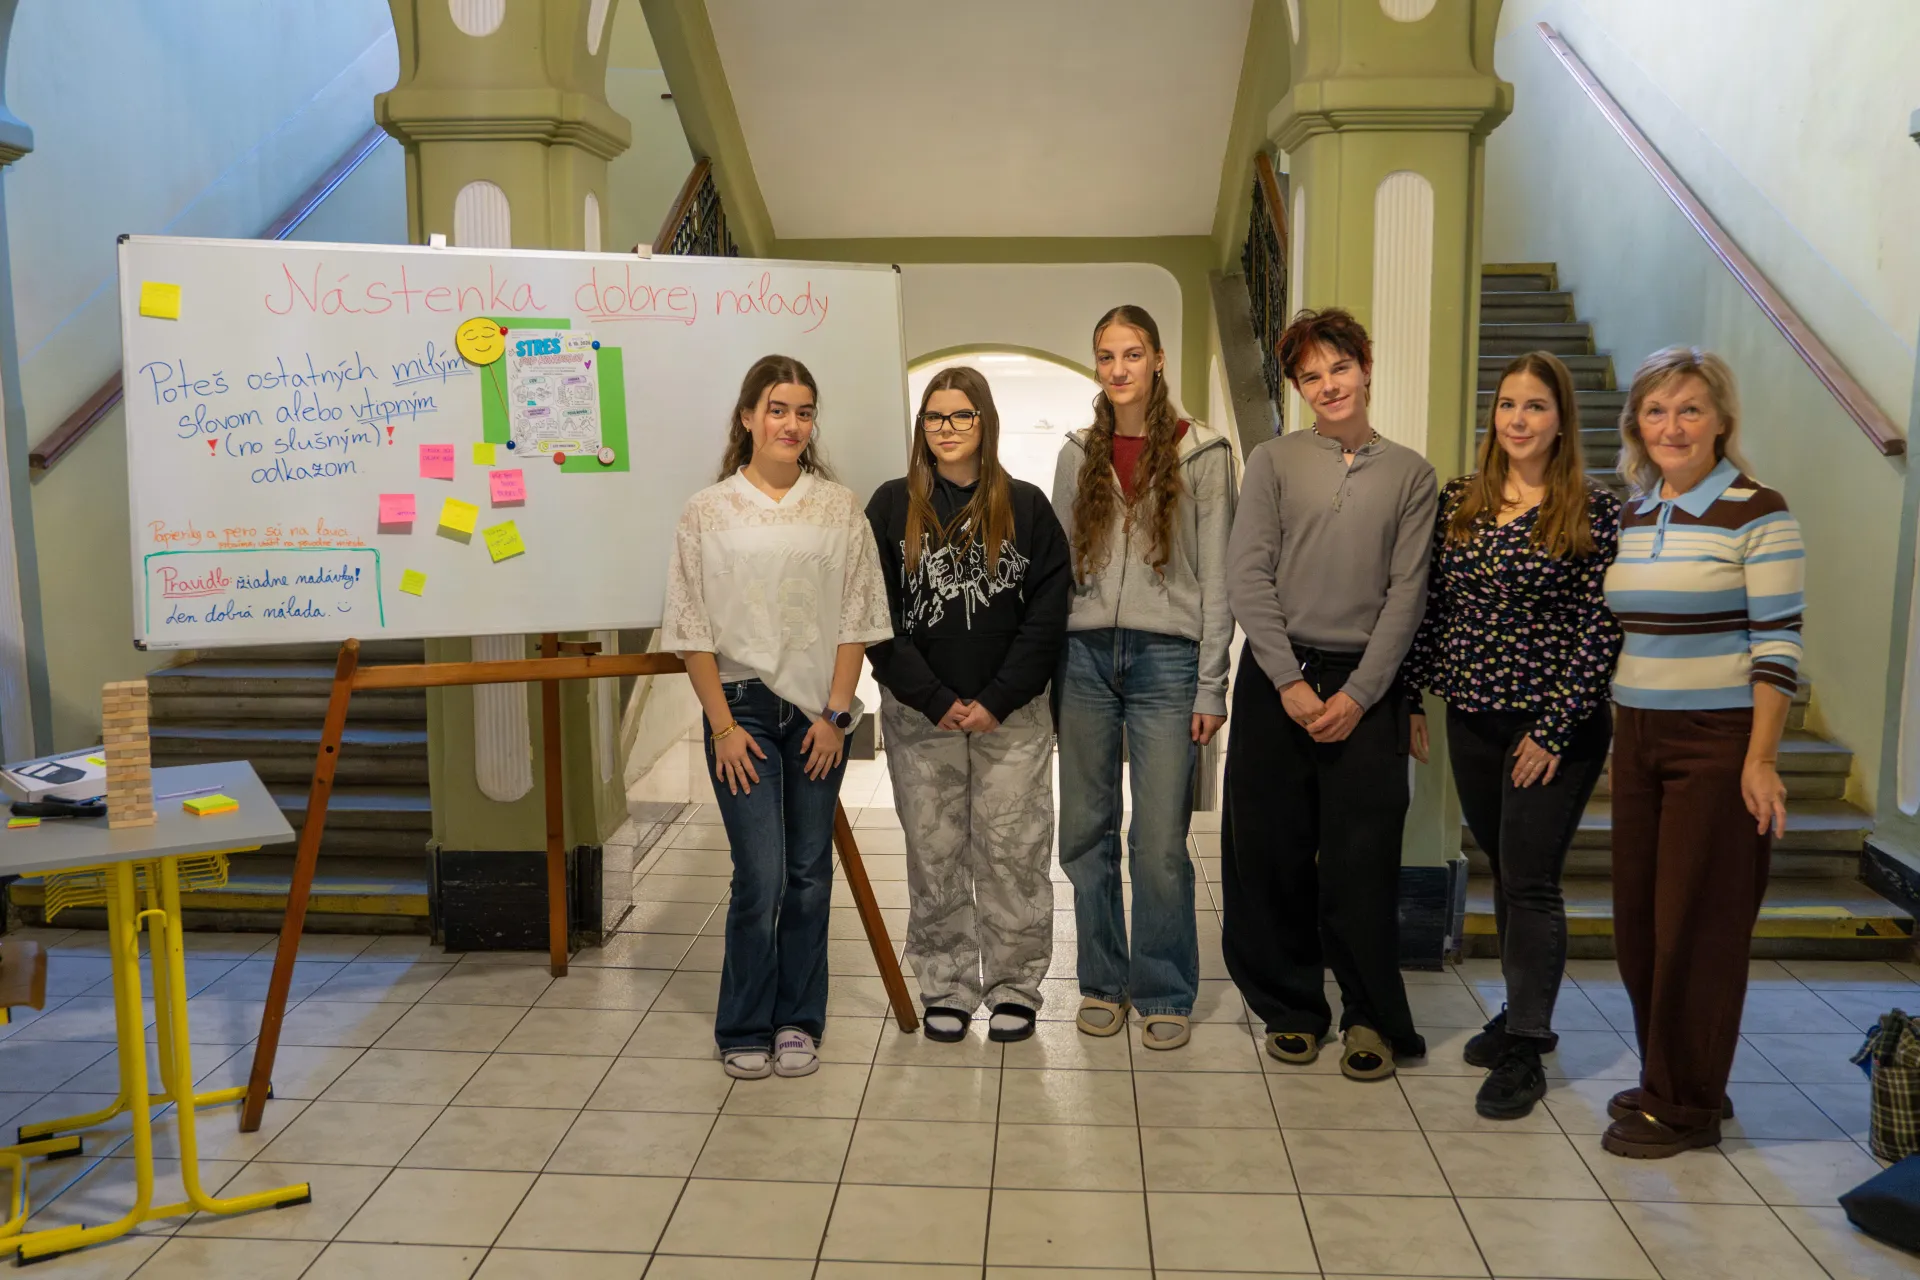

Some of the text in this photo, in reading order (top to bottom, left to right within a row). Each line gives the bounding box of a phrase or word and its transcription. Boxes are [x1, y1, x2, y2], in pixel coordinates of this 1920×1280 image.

[265, 263, 828, 333] Nástenka dobrej nálady
[516, 338, 561, 357] STRES
[139, 341, 468, 405] Poteš ostatných milým
[178, 390, 437, 439] slovom alebo vtipným
[275, 424, 381, 455] slušným)
[207, 530, 217, 538] a
[289, 527, 309, 537] na
[237, 569, 289, 589] žiadne
[295, 564, 361, 589] nadávky!
[166, 604, 198, 624] Len
[205, 599, 253, 623] dobrá
[779, 1041, 803, 1049] PUMA
